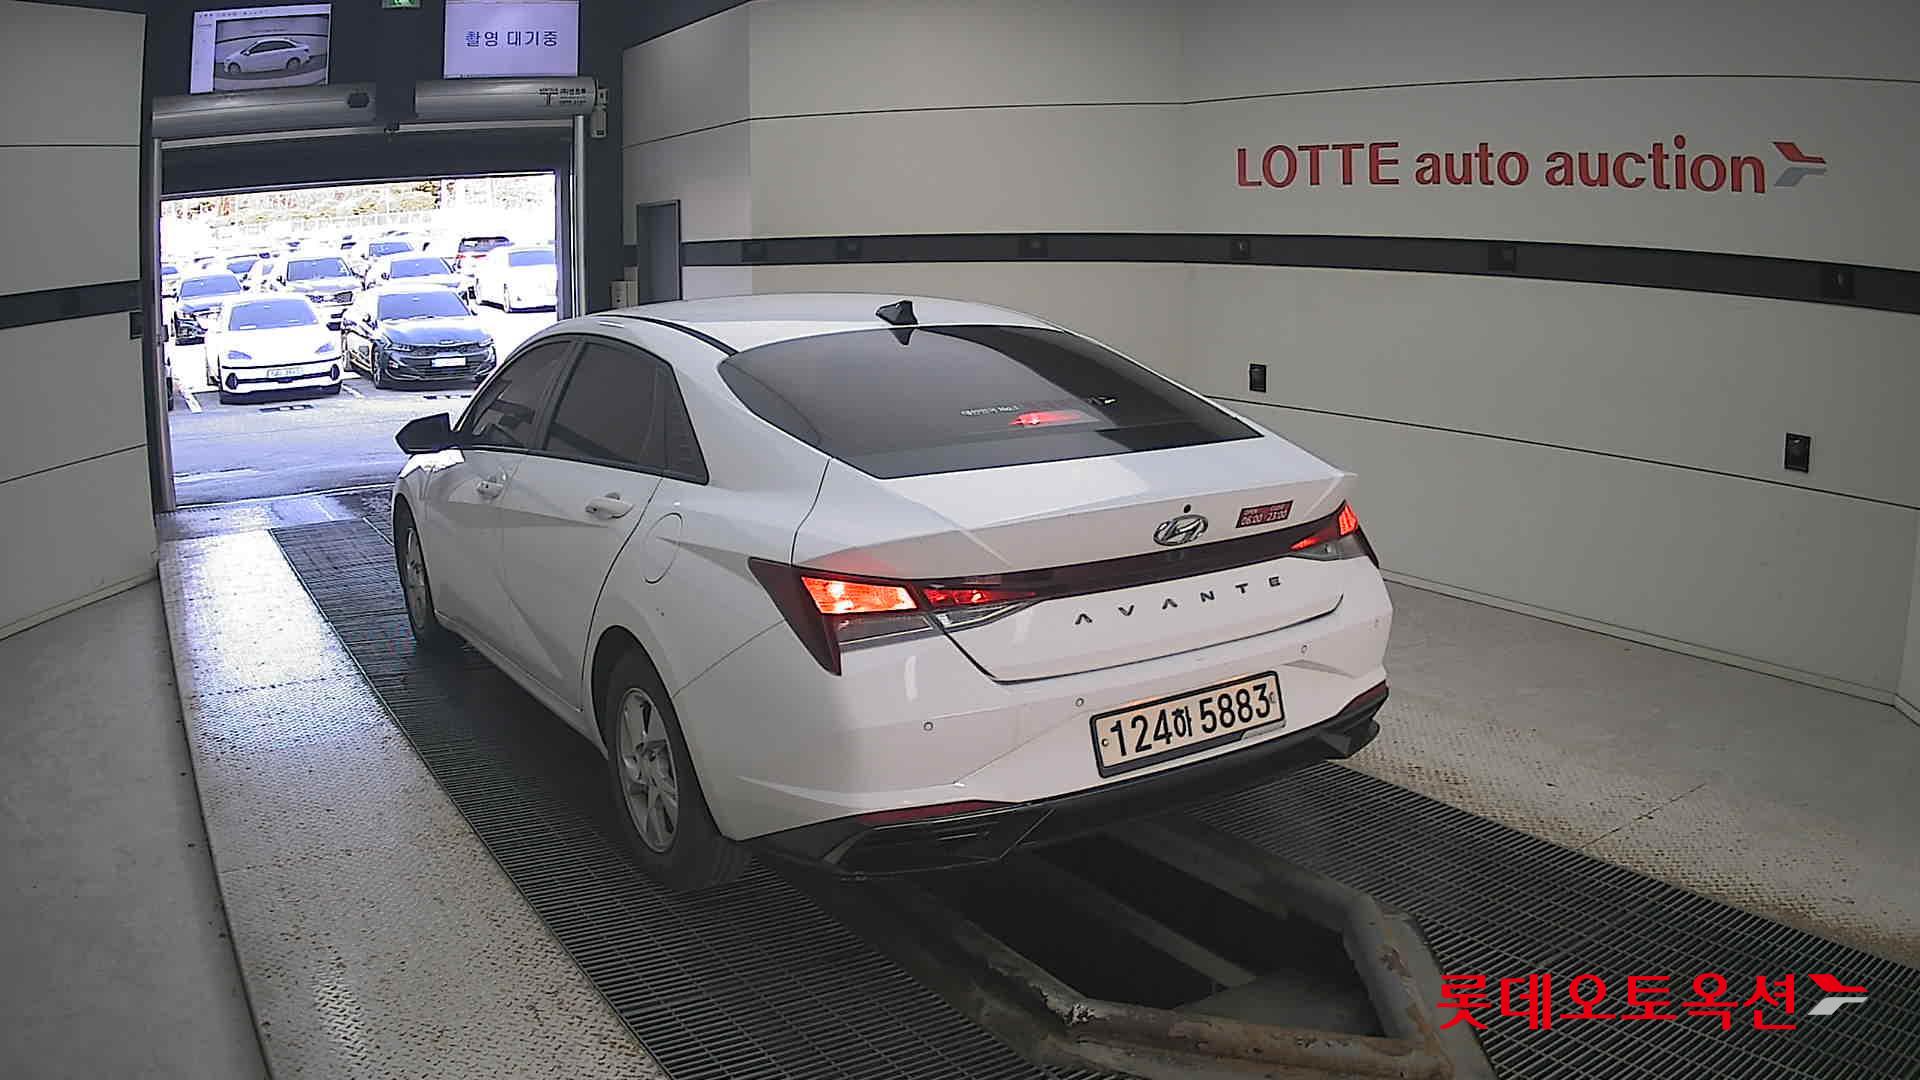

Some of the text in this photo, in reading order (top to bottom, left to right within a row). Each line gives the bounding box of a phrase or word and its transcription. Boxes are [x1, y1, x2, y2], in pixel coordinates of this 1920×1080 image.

[506, 30, 558, 48] 대기중
[1236, 134, 1766, 194] LOTTE auto auction
[1074, 575, 1281, 625] AVANTE
[1110, 683, 1271, 757] 124하 5883
